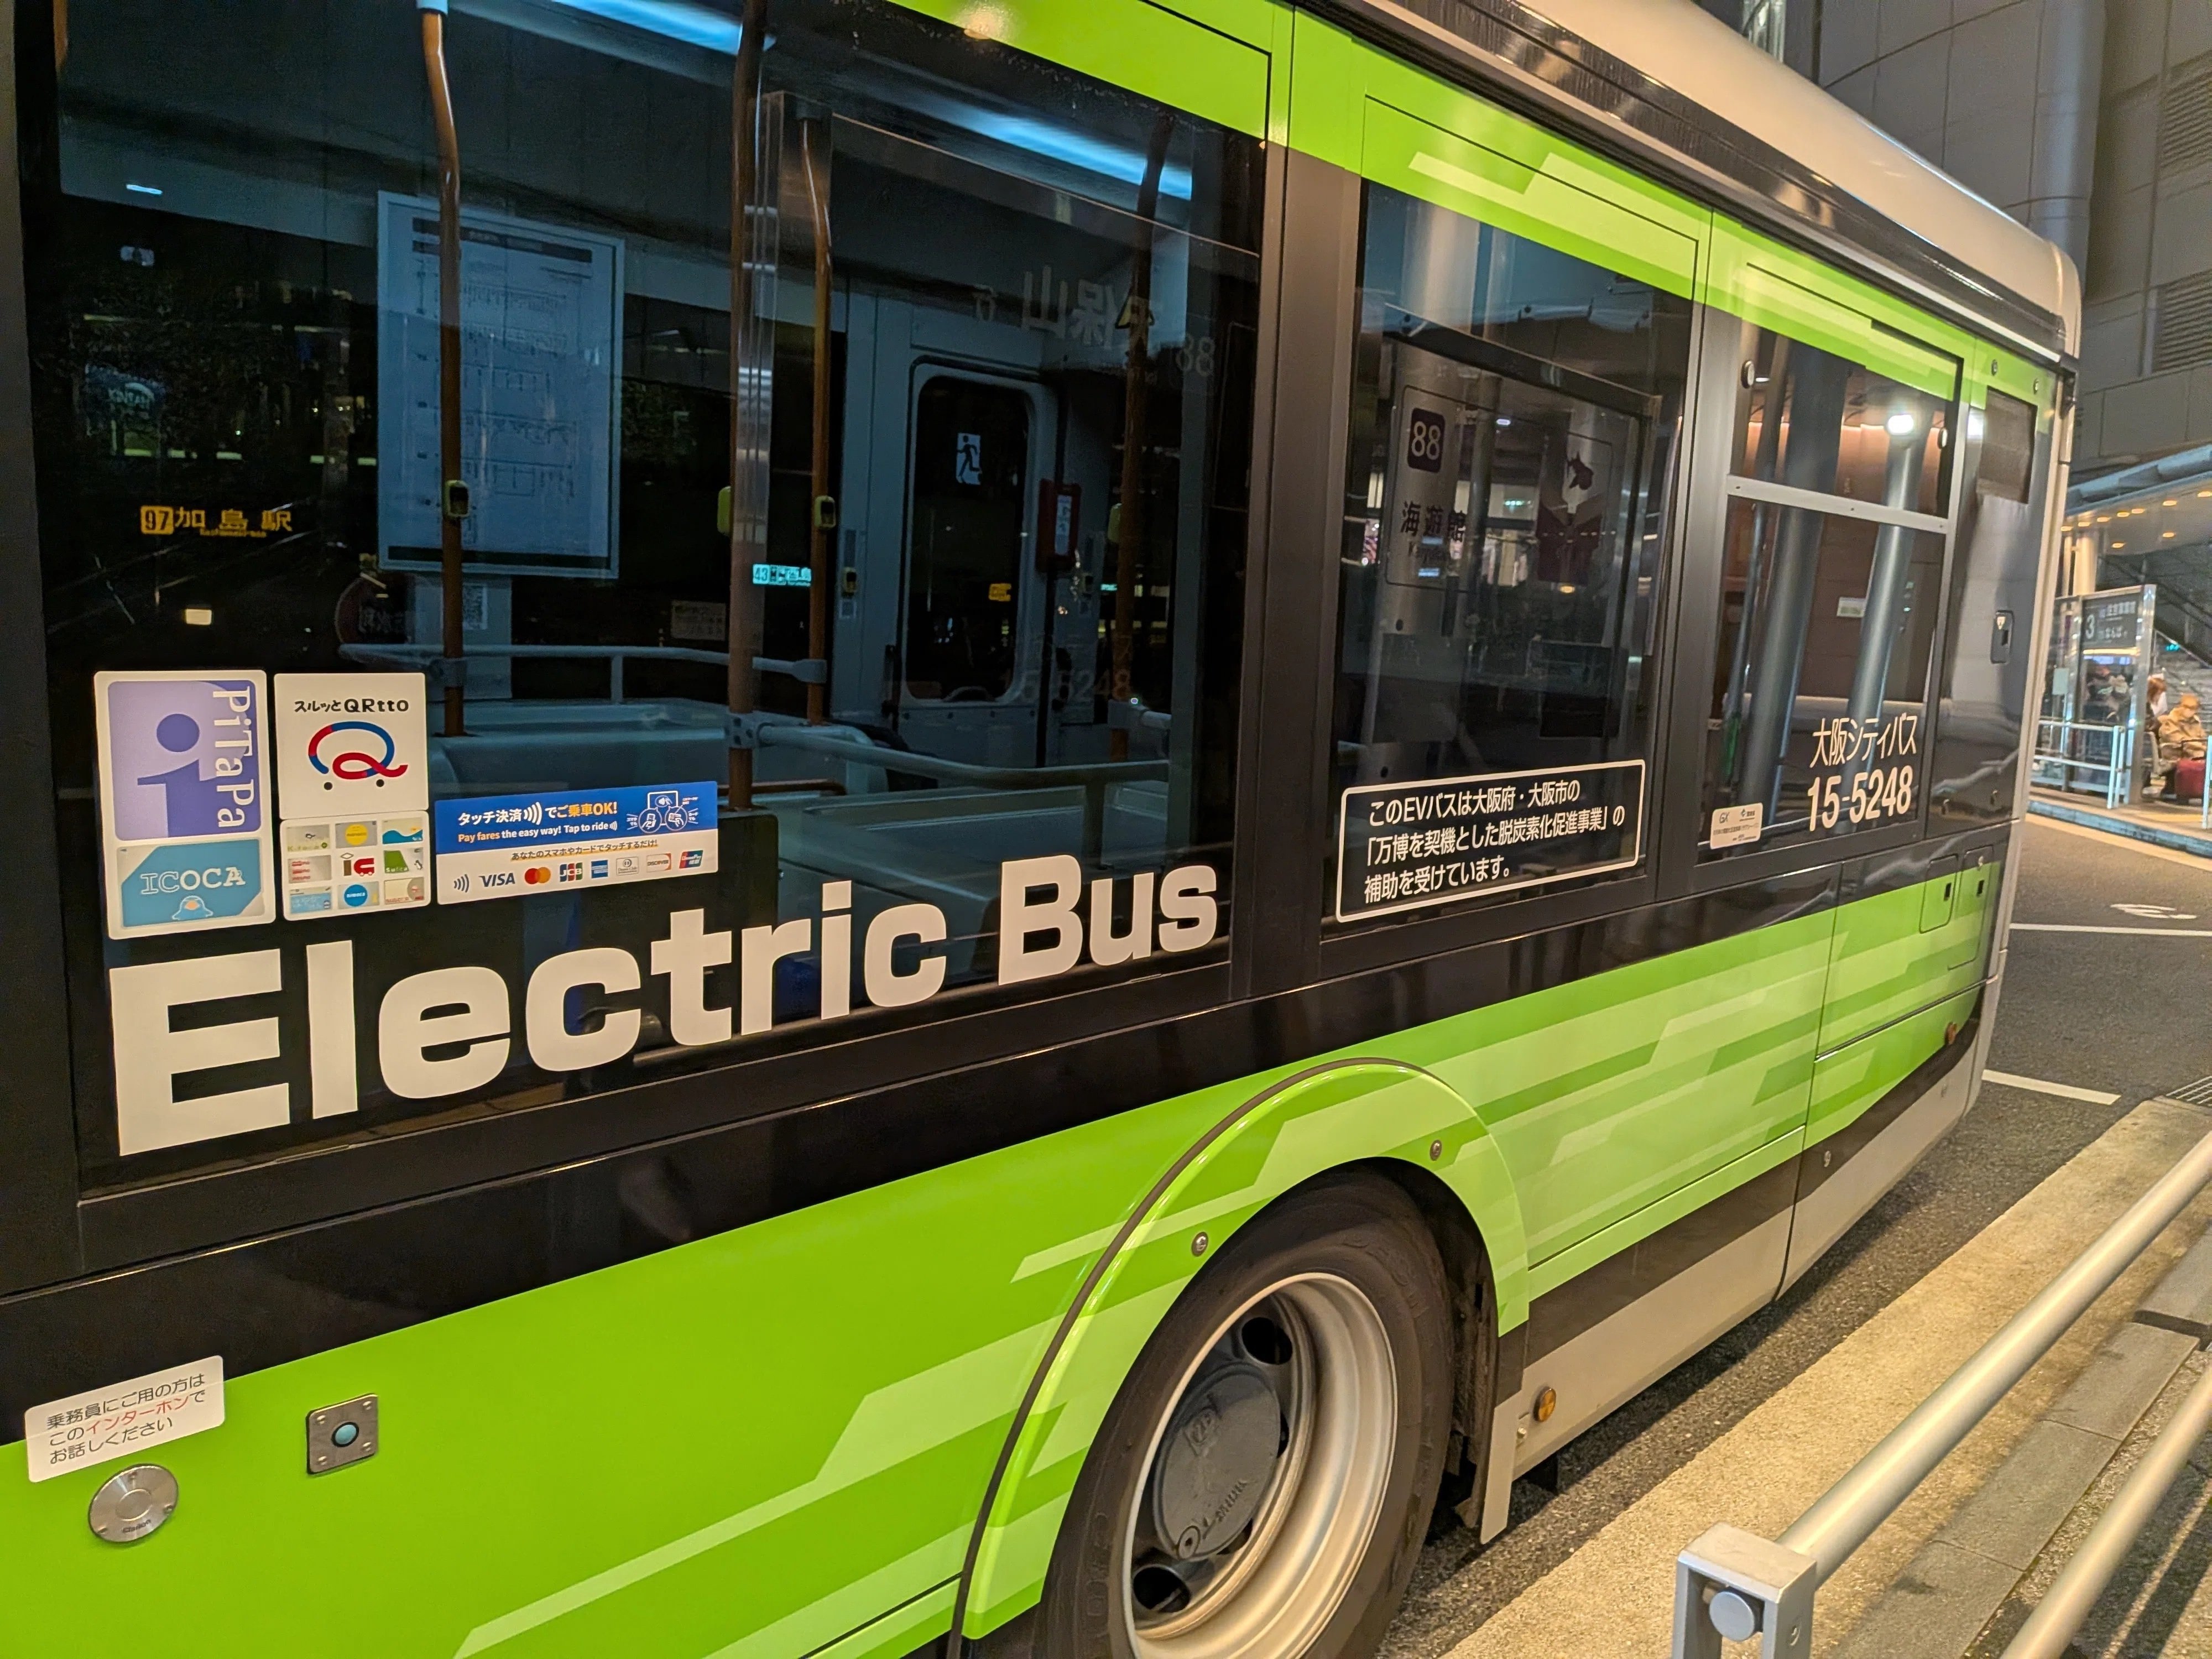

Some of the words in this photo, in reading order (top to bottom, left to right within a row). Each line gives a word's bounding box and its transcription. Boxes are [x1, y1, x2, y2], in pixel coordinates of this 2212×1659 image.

[1411, 421, 1441, 461] 88
[144, 509, 170, 531] 97
[2085, 614, 2095, 639] 3
[294, 698, 409, 713] スルッとQRtto
[213, 686, 254, 827] PiTaPa
[1810, 713, 1918, 768] 大阪シティバス
[458, 808, 522, 826] タッチ決済
[545, 801, 618, 818] でご乗車OK!
[1369, 779, 1580, 827] このEVバスは大阪府・大阪市の
[1807, 765, 1913, 832] 15-5248
[458, 833, 475, 844] Pay
[477, 831, 500, 841] fares
[501, 830, 518, 839] the
[518, 828, 539, 838] easy
[540, 825, 562, 836] way!
[564, 825, 580, 834] Tap
[581, 823, 591, 832] to
[591, 821, 608, 831] ride
[511, 839, 658, 860] あなたのスマホやカードでタッチするだけ!
[140, 867, 246, 895] ICOCA
[478, 872, 516, 888] VISA
[1364, 854, 1510, 904] 補助を受けています。
[109, 883, 947, 1156] Electric
[998, 854, 1219, 985] Bus
[47, 1373, 205, 1430] 乗務員にご用の方は
[49, 1389, 206, 1447] このインターホンで
[49, 1417, 173, 1464] お話しください
